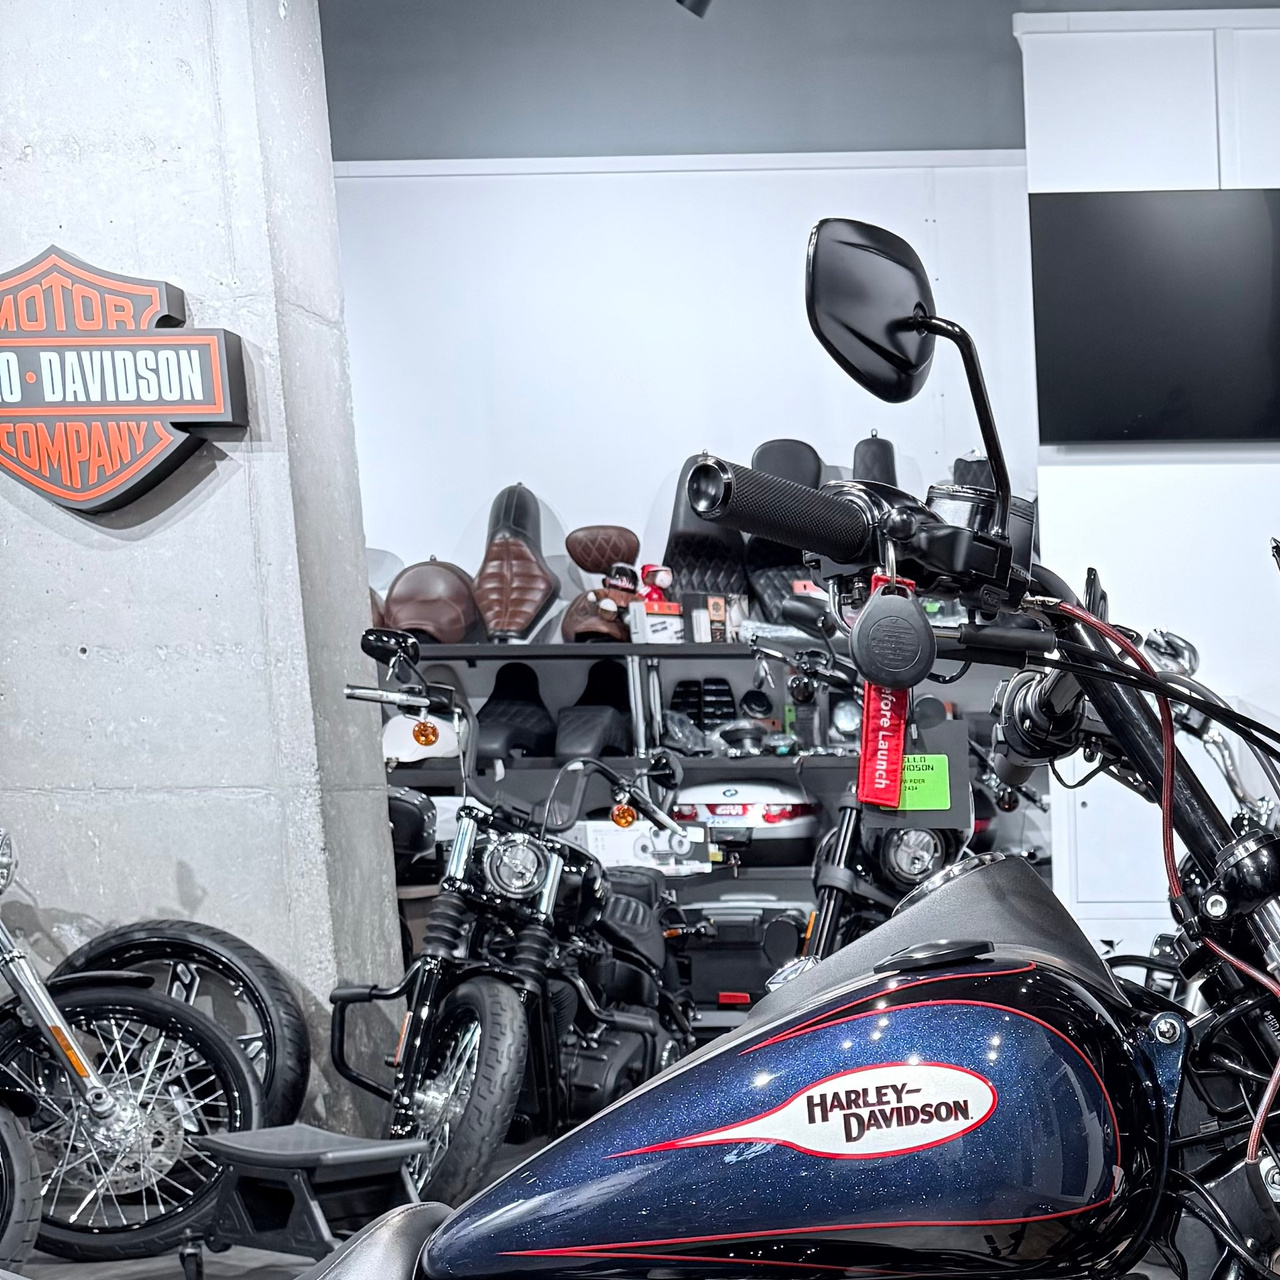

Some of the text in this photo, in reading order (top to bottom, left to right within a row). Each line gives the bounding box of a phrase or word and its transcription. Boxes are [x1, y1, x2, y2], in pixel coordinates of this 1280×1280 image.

[39, 349, 204, 402] DAVIDSON
[0, 421, 148, 489] COMPANY
[874, 688, 896, 789] fore Launch
[902, 764, 935, 772] VIDSON
